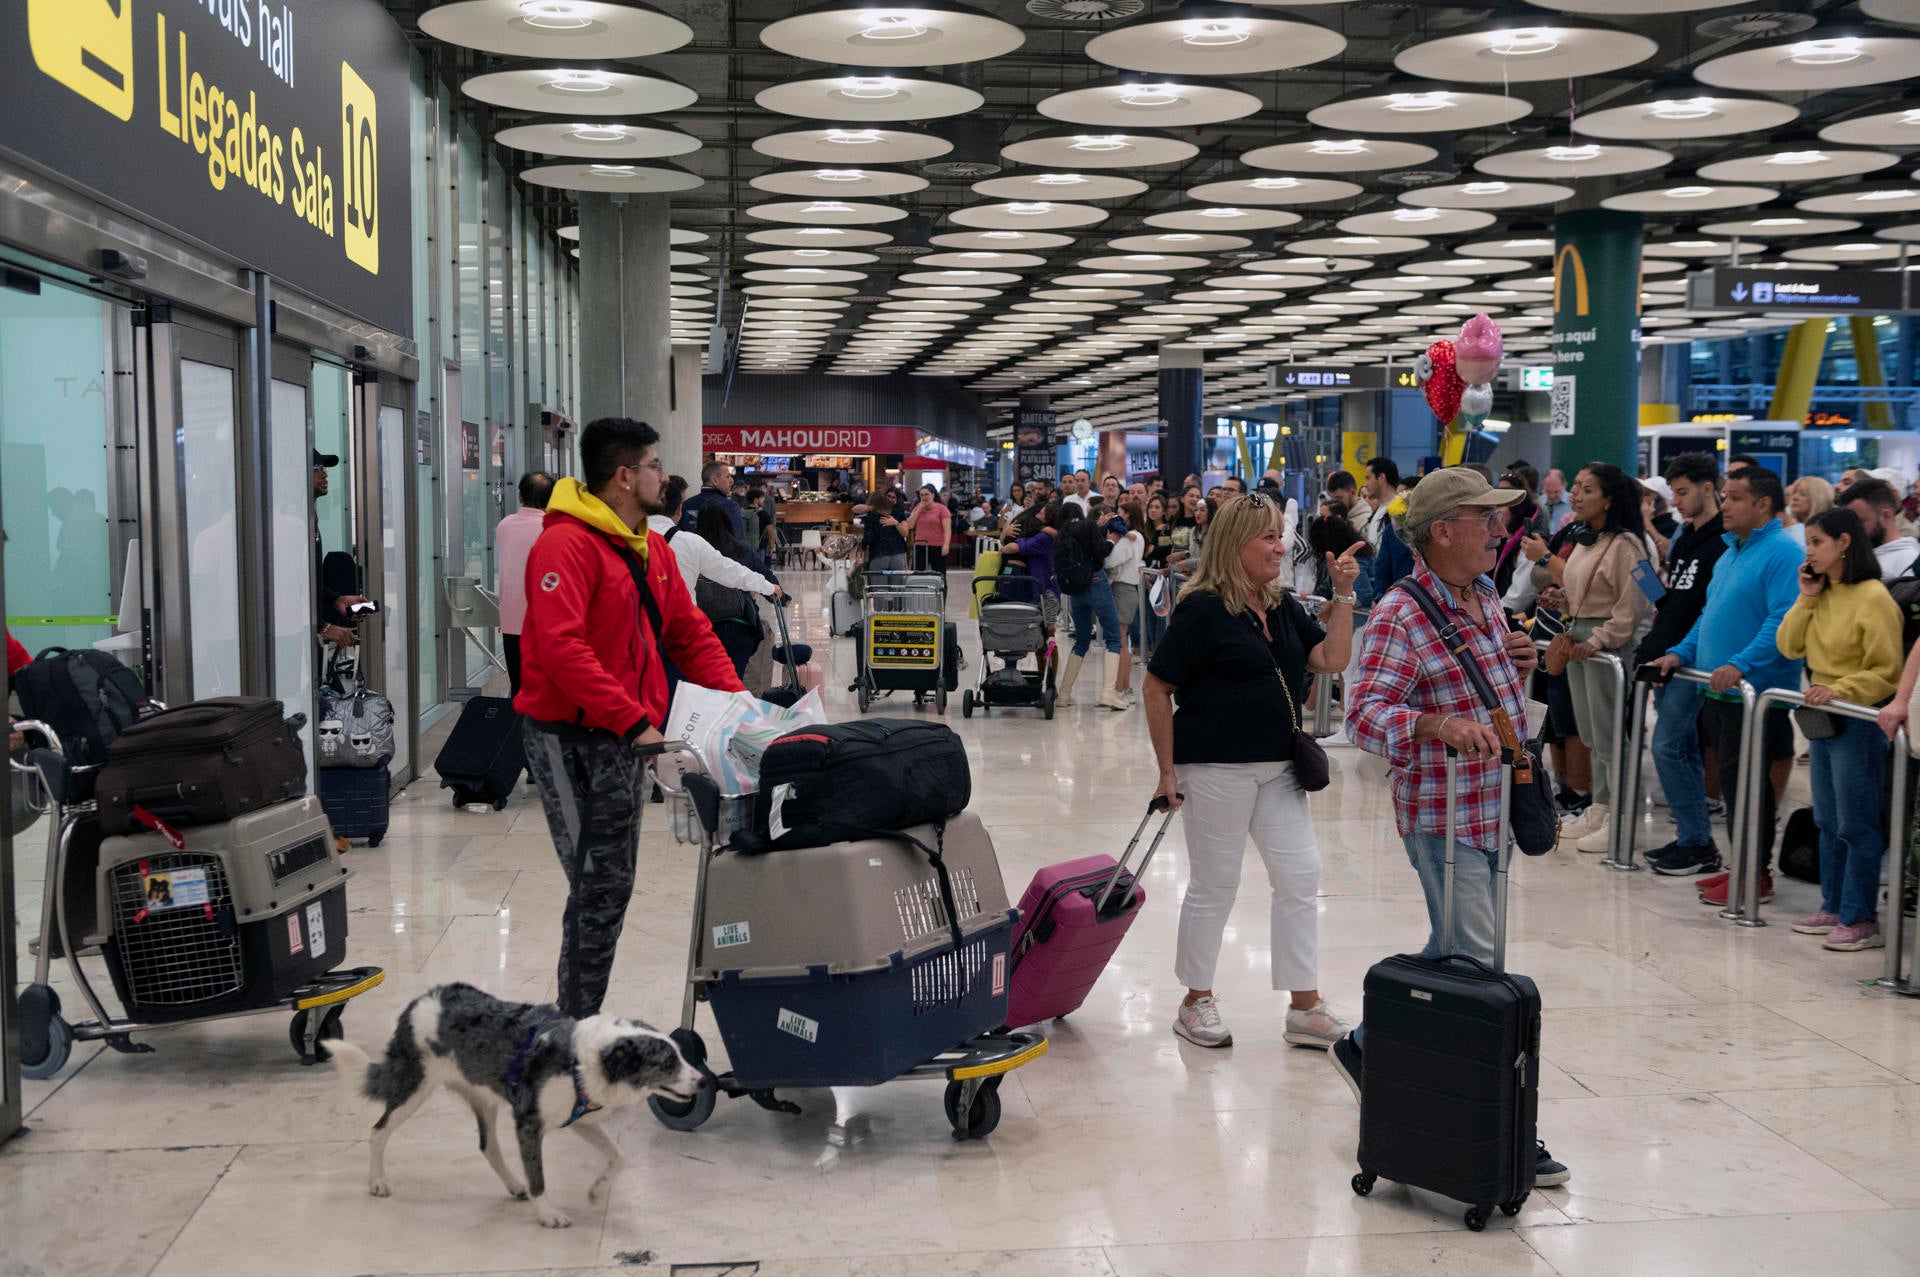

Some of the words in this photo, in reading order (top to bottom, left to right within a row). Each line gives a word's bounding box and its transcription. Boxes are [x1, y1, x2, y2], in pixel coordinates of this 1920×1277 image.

[157, 12, 285, 205] Llegadas
[291, 126, 334, 237] Sala
[345, 102, 376, 238] 10
[1565, 327, 1597, 345] aquí
[740, 430, 871, 448] MAHOUDRID
[717, 932, 748, 946] ANIMALS
[723, 924, 739, 936] LIVE
[780, 1020, 814, 1040] ANIMALS
[790, 1015, 806, 1029] LIVE
